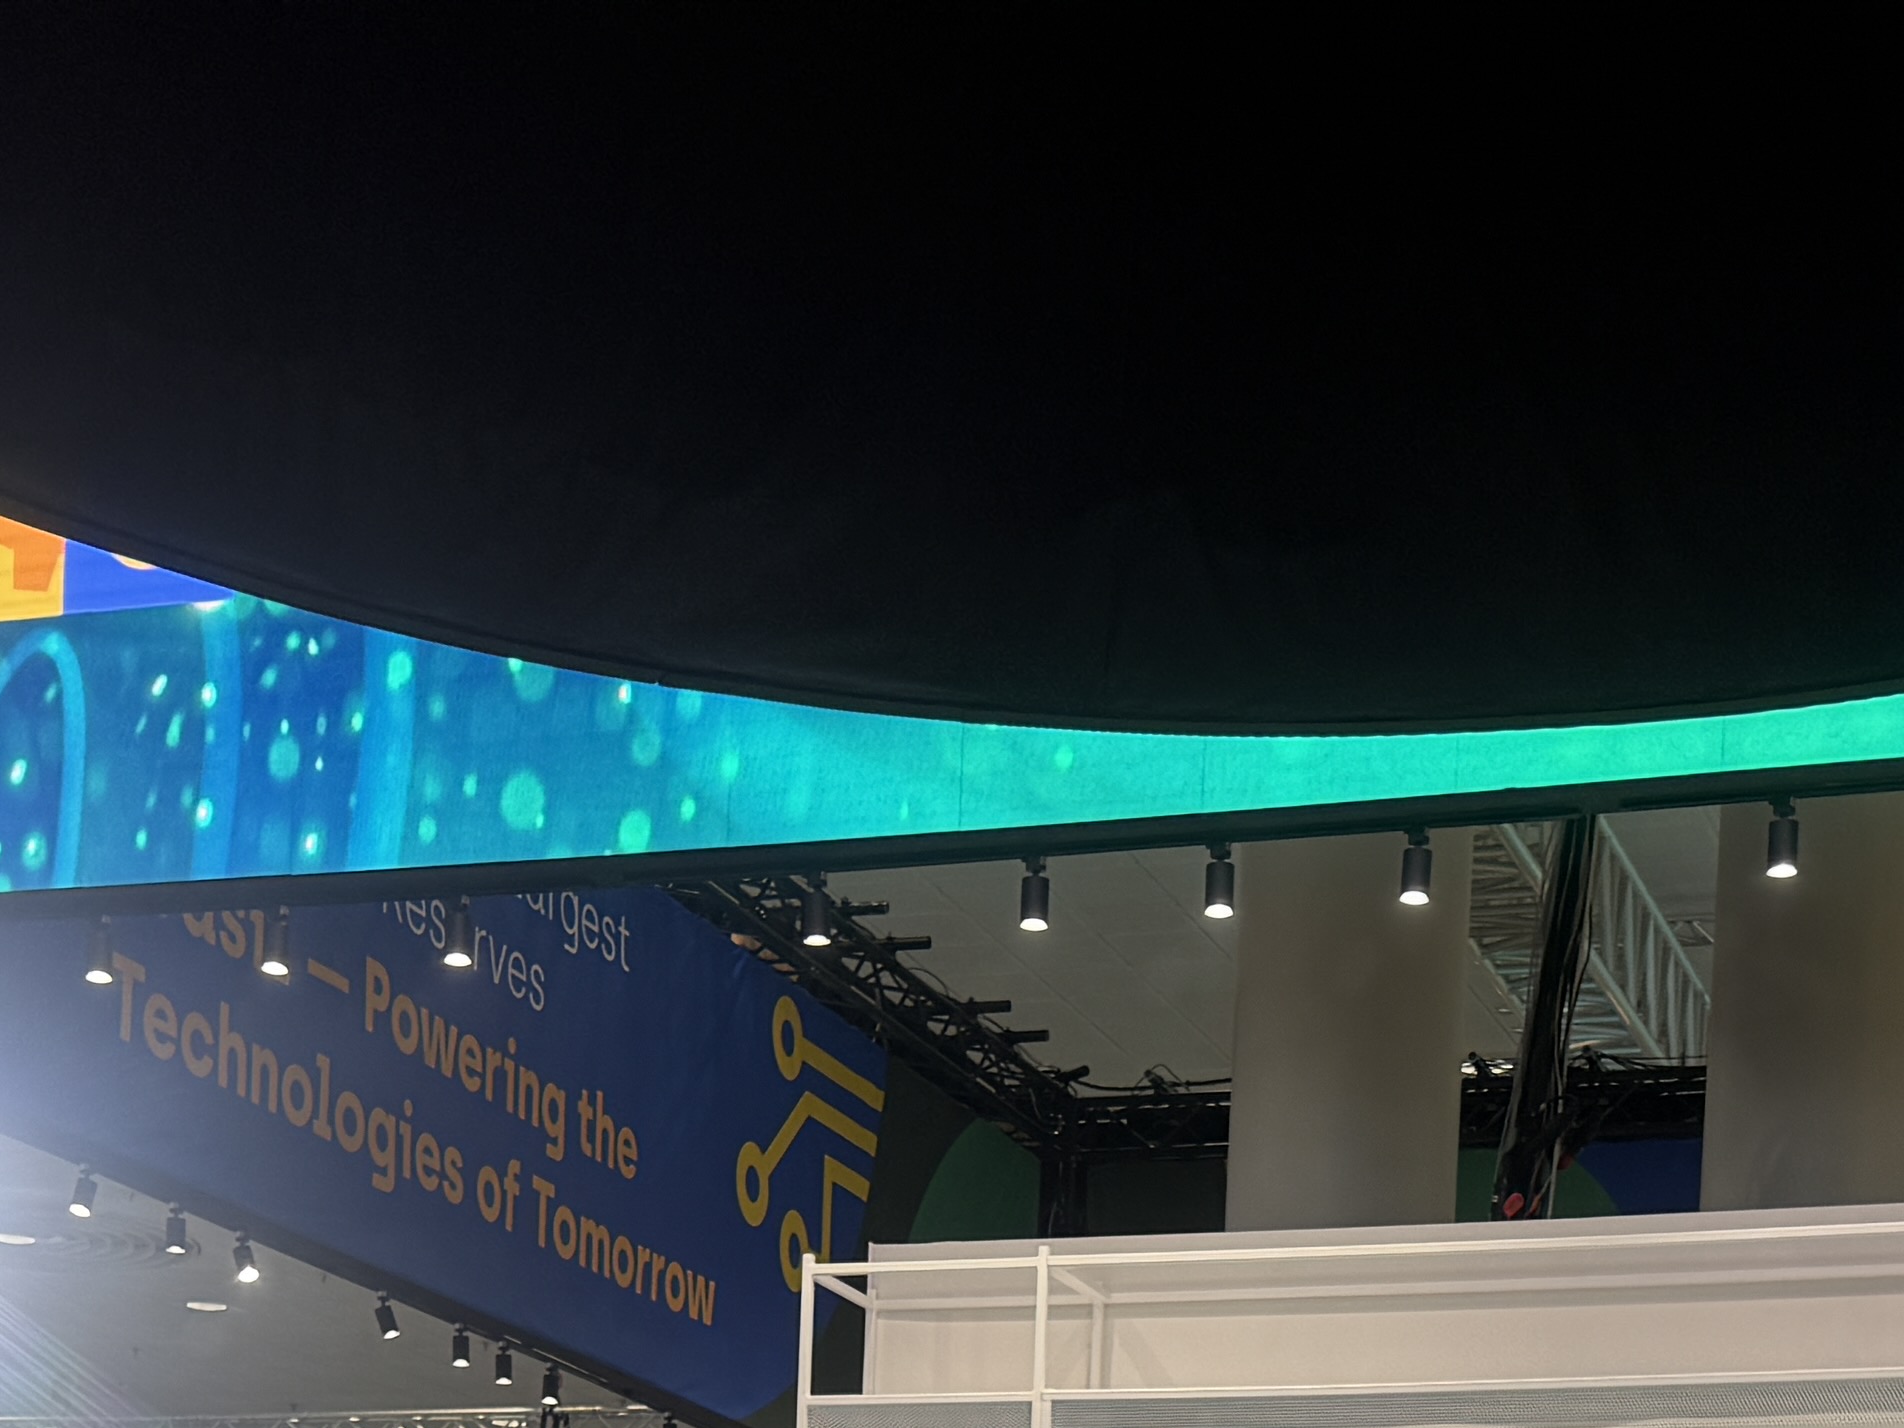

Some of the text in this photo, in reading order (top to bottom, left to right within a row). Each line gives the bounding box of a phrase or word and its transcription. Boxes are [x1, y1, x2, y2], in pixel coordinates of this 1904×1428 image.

[382, 899, 545, 1012] esrves
[516, 891, 630, 973] rgest
[112, 953, 717, 1327] Technologies of Tomorrow
[365, 955, 565, 1162] Powering
[577, 1089, 638, 1180] the
